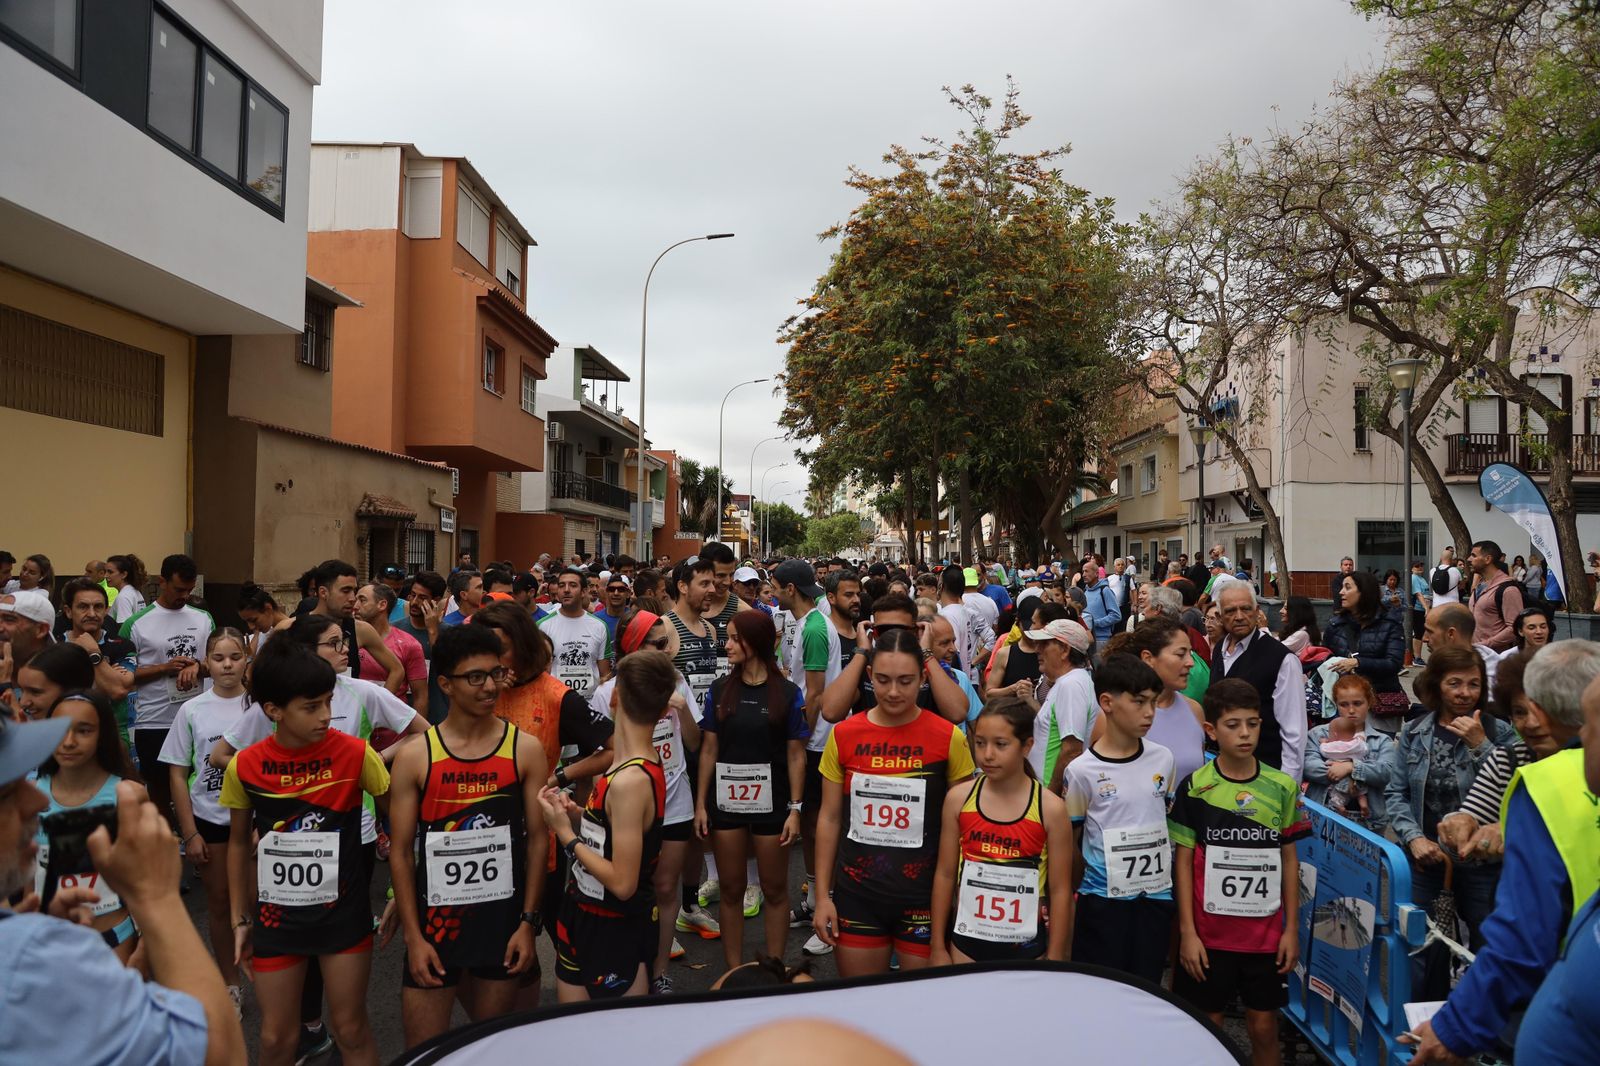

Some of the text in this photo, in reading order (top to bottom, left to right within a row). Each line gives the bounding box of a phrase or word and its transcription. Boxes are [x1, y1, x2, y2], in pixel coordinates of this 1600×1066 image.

[564, 679, 588, 691] 902
[855, 741, 924, 759] Málaga
[262, 757, 333, 775] Málaga
[871, 756, 923, 769] Bahía
[280, 769, 333, 787] Bahía
[441, 771, 498, 785] Málaga
[457, 781, 498, 794] Bahía
[727, 784, 762, 801] 127
[863, 803, 910, 830] 198
[969, 830, 1021, 849] Málaga
[1206, 826, 1279, 841] tecnoaire
[981, 842, 1020, 857] Bahía
[272, 861, 324, 887] 900
[444, 857, 499, 886] 926
[1122, 851, 1164, 879] 721
[1221, 875, 1269, 899] 674
[973, 894, 1023, 924] 151
